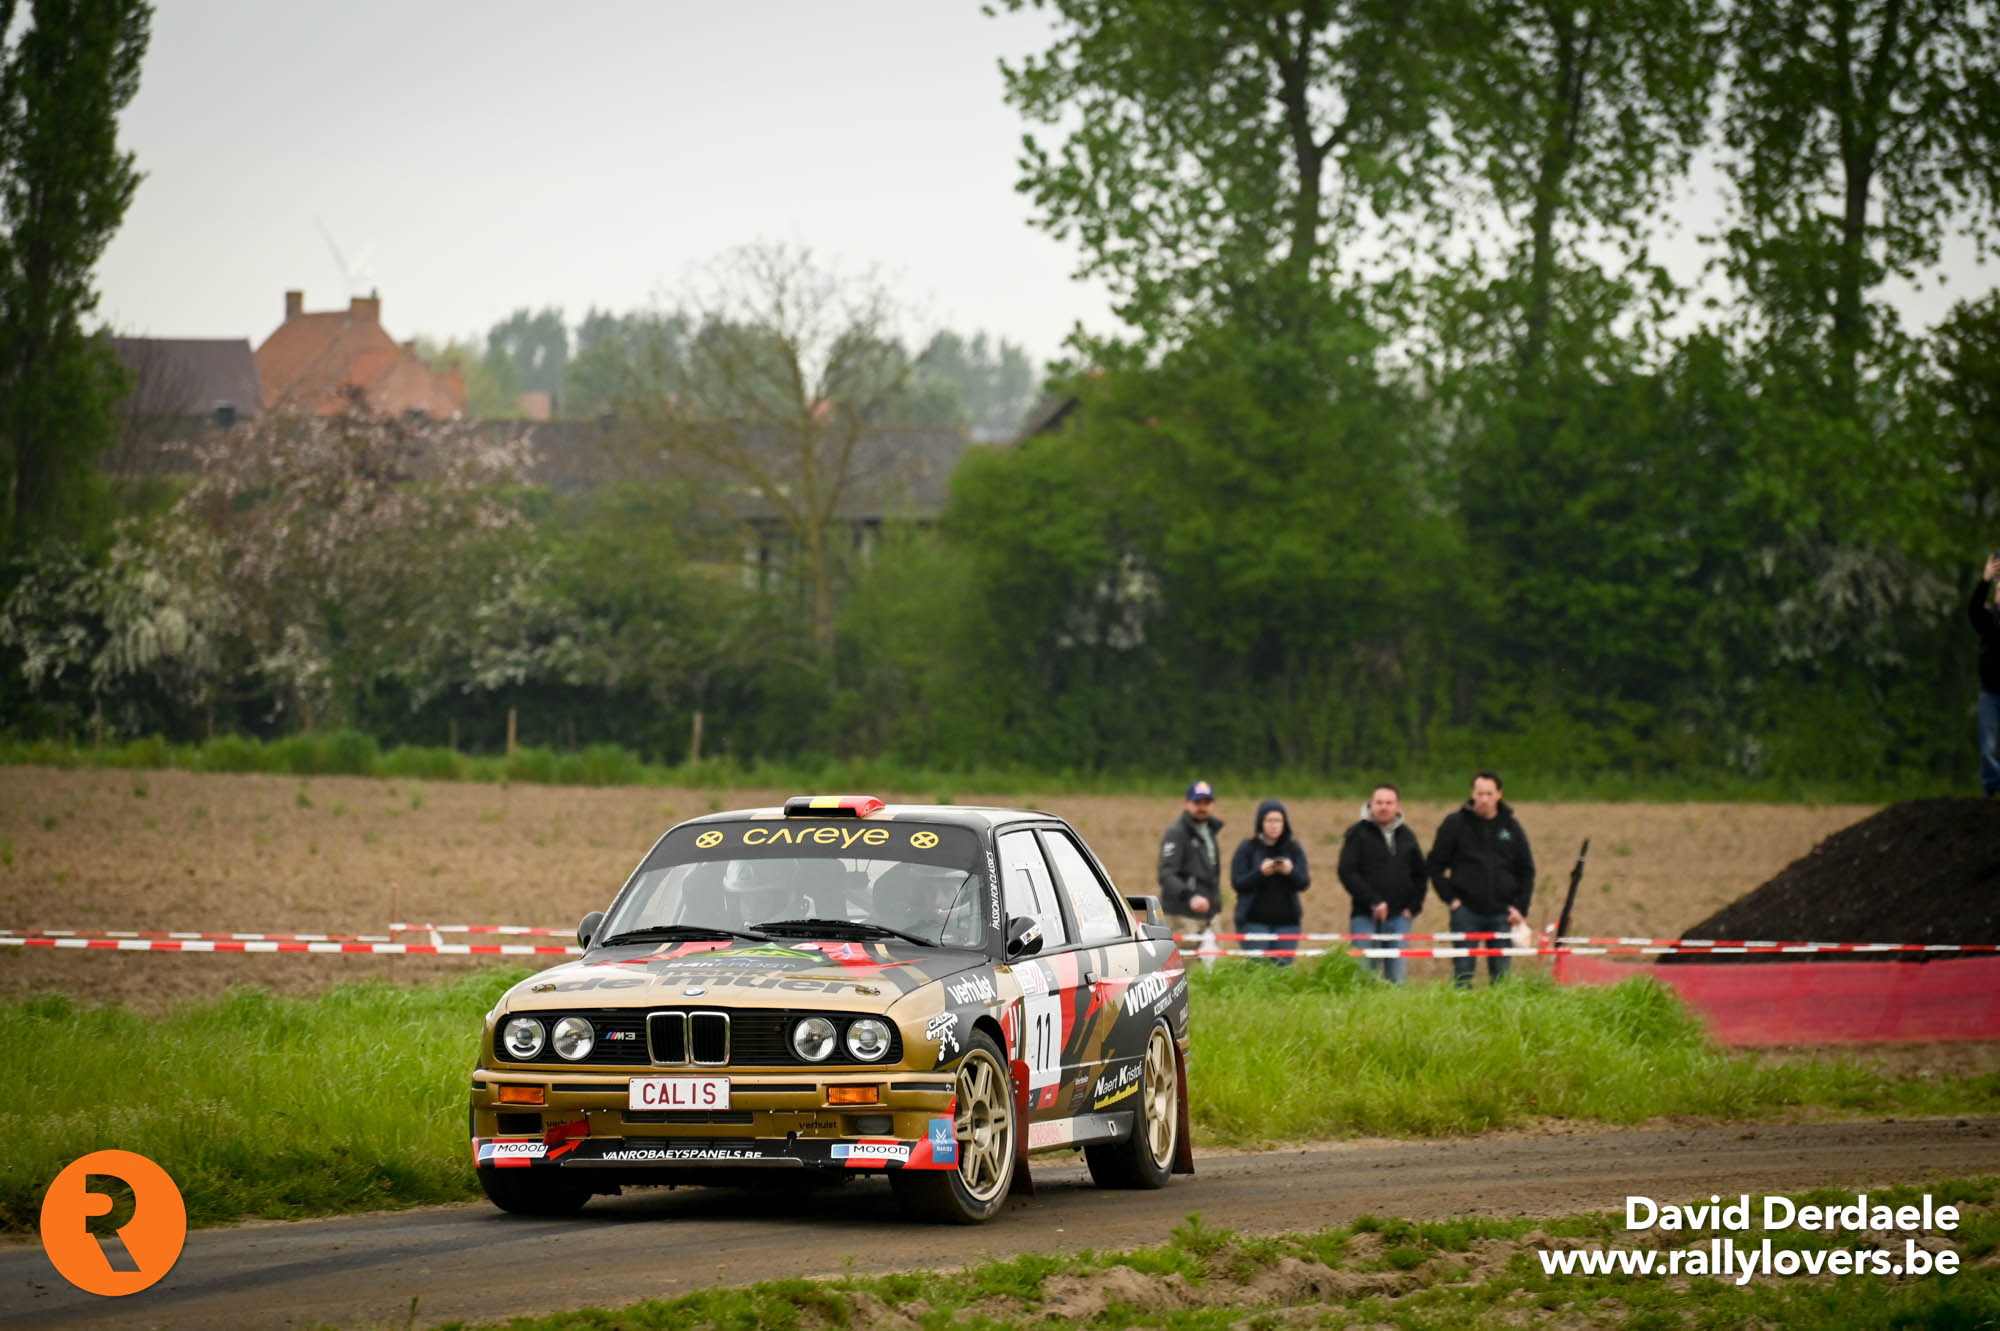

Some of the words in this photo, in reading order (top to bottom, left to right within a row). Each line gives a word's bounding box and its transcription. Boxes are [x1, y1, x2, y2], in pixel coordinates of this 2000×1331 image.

[990, 883, 999, 900] FOR
[991, 900, 1000, 930] PASSION
[554, 977, 645, 993] de
[947, 974, 997, 1005] verhulst
[1124, 971, 1168, 1017] WORLD
[613, 1031, 636, 1041] M3
[1036, 1012, 1051, 1071] 11
[642, 1083, 717, 1105] CALIS
[1093, 1075, 1118, 1098] Naert
[497, 1144, 547, 1153] MOOOD
[602, 1150, 762, 1160] VANROBAEYSPANELS.BE
[853, 1145, 908, 1155] MOOOD
